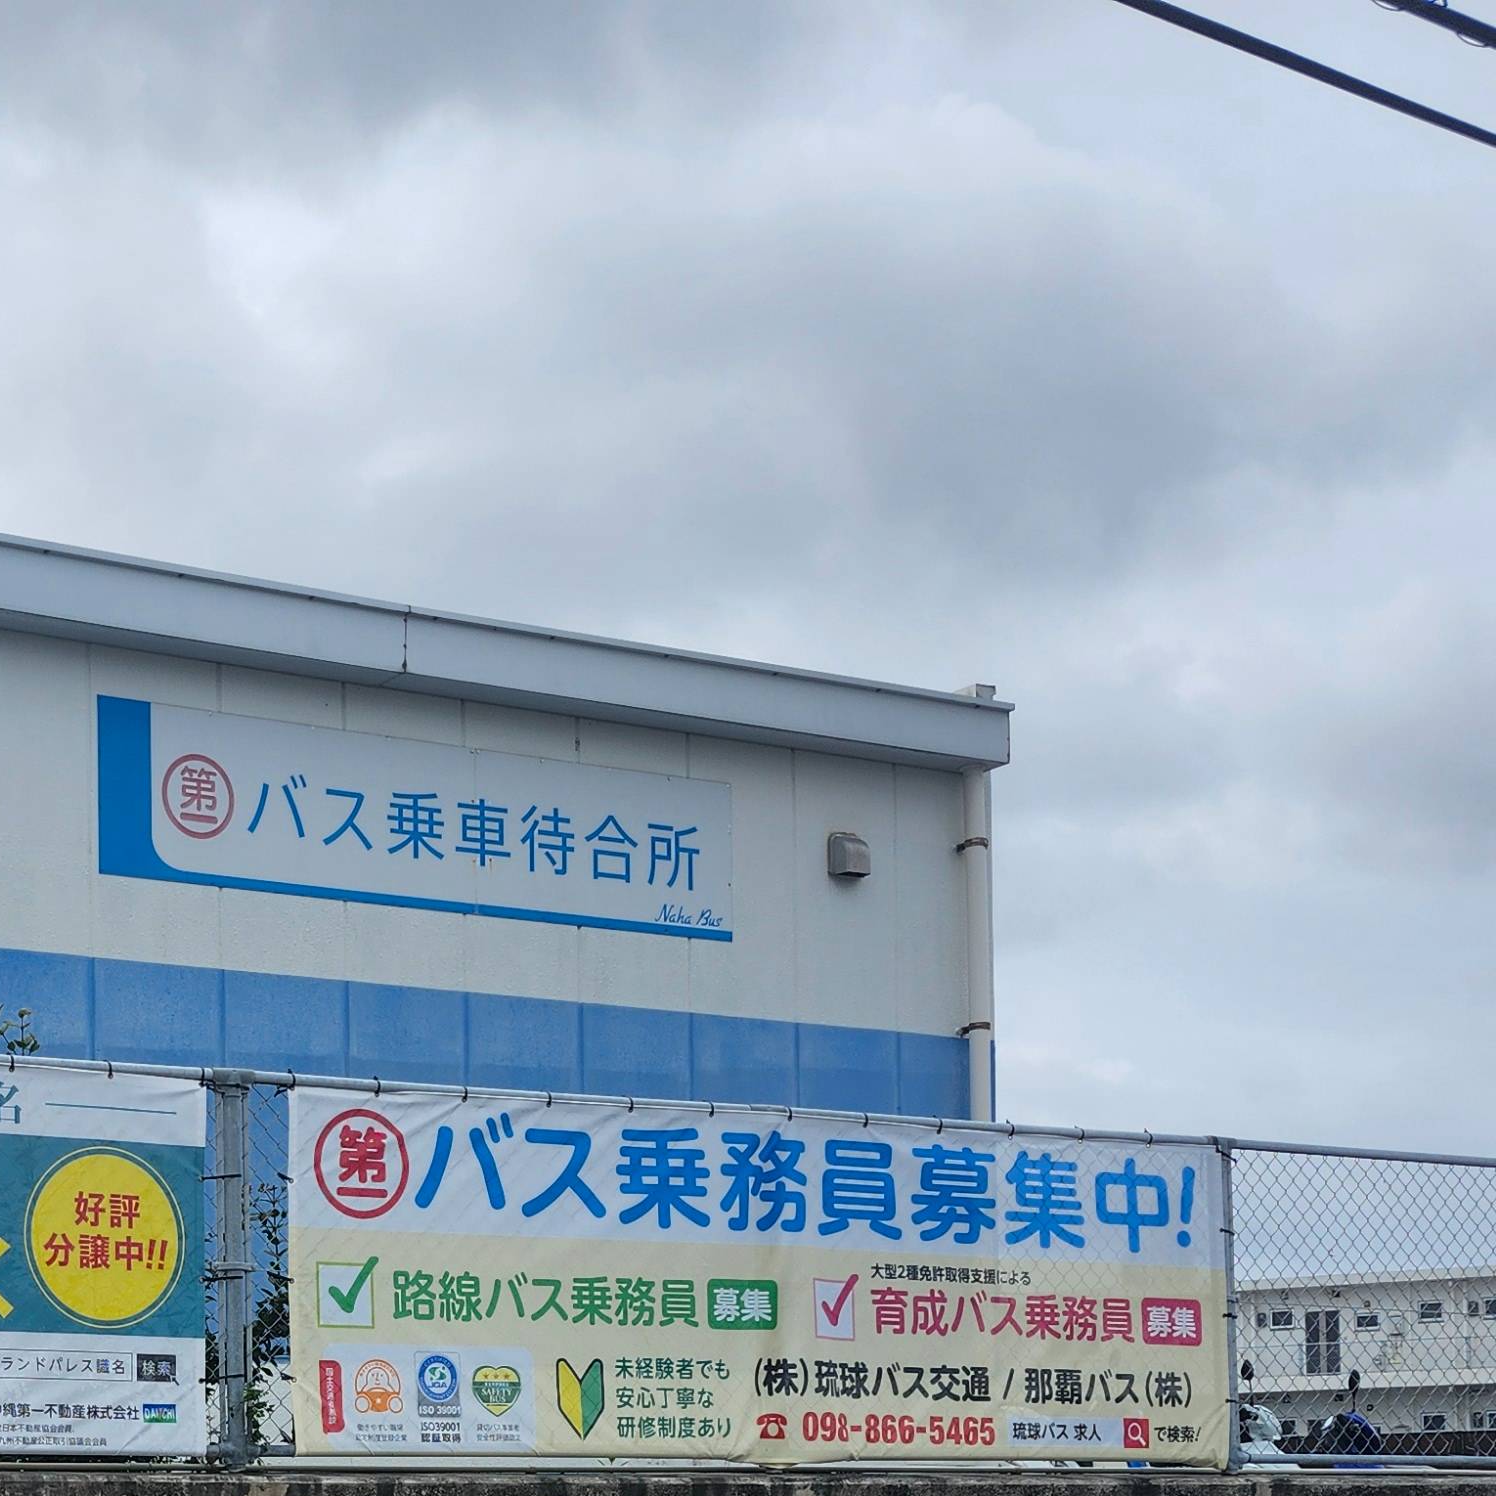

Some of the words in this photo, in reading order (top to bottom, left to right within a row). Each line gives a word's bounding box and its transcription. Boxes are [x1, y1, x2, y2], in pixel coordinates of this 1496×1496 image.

[246, 774, 701, 891] バス乗車待合所
[655, 903, 692, 925] Naha
[696, 909, 723, 927] Bus
[414, 1112, 1196, 1254] バス乗務員募集中!
[73, 1191, 141, 1227] 好評
[43, 1232, 167, 1272] 分譲中!!
[870, 1262, 1033, 1287] 大型2種免許取得支援による
[392, 1268, 700, 1328] 路線バス乗務員
[712, 1287, 773, 1323] 募集
[869, 1286, 1136, 1344] 育成バス乗務員
[1146, 1305, 1198, 1339] 募集
[141, 1359, 173, 1377] 検索
[614, 1356, 731, 1381] 未経験者でも
[753, 1358, 992, 1402] (株)琉球バス交通
[1023, 1366, 1193, 1410] 那覇バス(株)
[419, 1406, 435, 1414] ISO
[615, 1386, 715, 1409] 安心丁寧な
[420, 1421, 461, 1432] ISO39001
[616, 1415, 732, 1439] 研修制度あり
[801, 1410, 997, 1447] 098-866-5465
[1011, 1421, 1070, 1442] 琉球バス
[1073, 1423, 1102, 1443] 求人
[1153, 1424, 1202, 1444] で検索!
